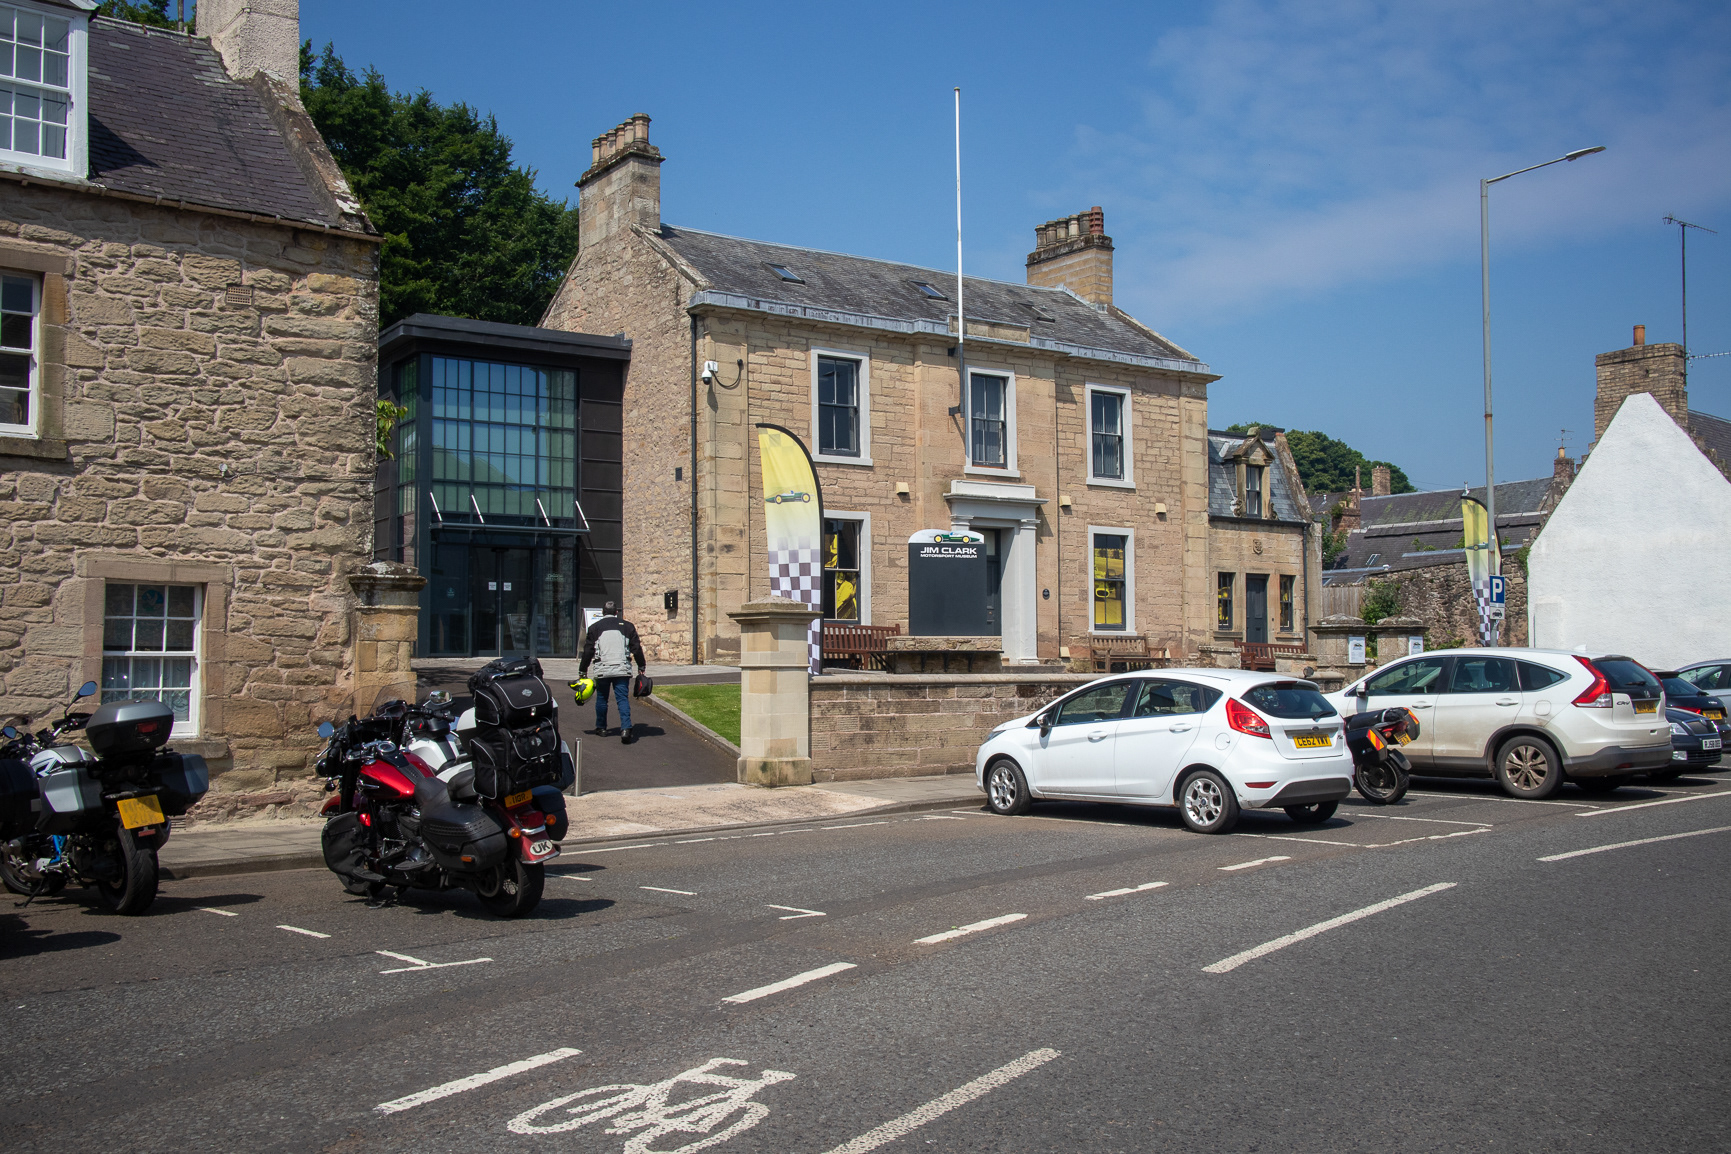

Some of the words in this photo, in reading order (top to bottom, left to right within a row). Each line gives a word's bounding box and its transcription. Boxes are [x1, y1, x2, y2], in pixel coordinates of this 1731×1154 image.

[920, 546, 939, 554] JIM
[941, 547, 977, 555] CLARK
[1492, 578, 1503, 602] P
[532, 841, 550, 854] UK
